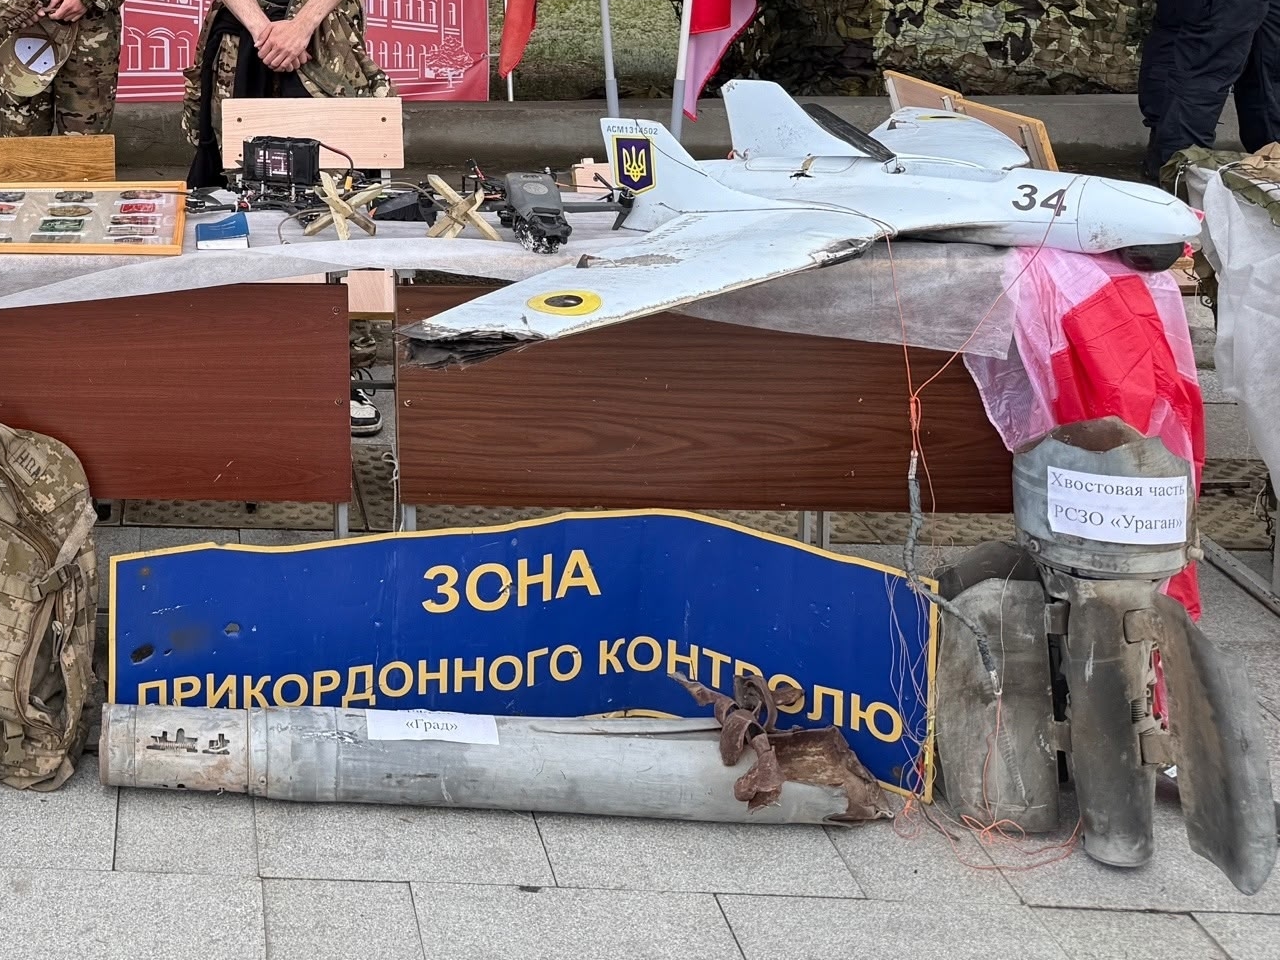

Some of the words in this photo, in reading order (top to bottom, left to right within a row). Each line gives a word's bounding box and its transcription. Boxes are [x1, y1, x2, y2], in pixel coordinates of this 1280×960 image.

[1011, 184, 1067, 217] 34
[1051, 471, 1143, 497] Хвостовая
[1149, 484, 1185, 497] часть
[1054, 504, 1104, 526] РСЗО
[1110, 514, 1182, 533] «Ураган»
[421, 549, 601, 614] ЗОНА
[136, 644, 583, 709] ПРИКОРДОННОГО
[405, 718, 458, 732] «Град»
